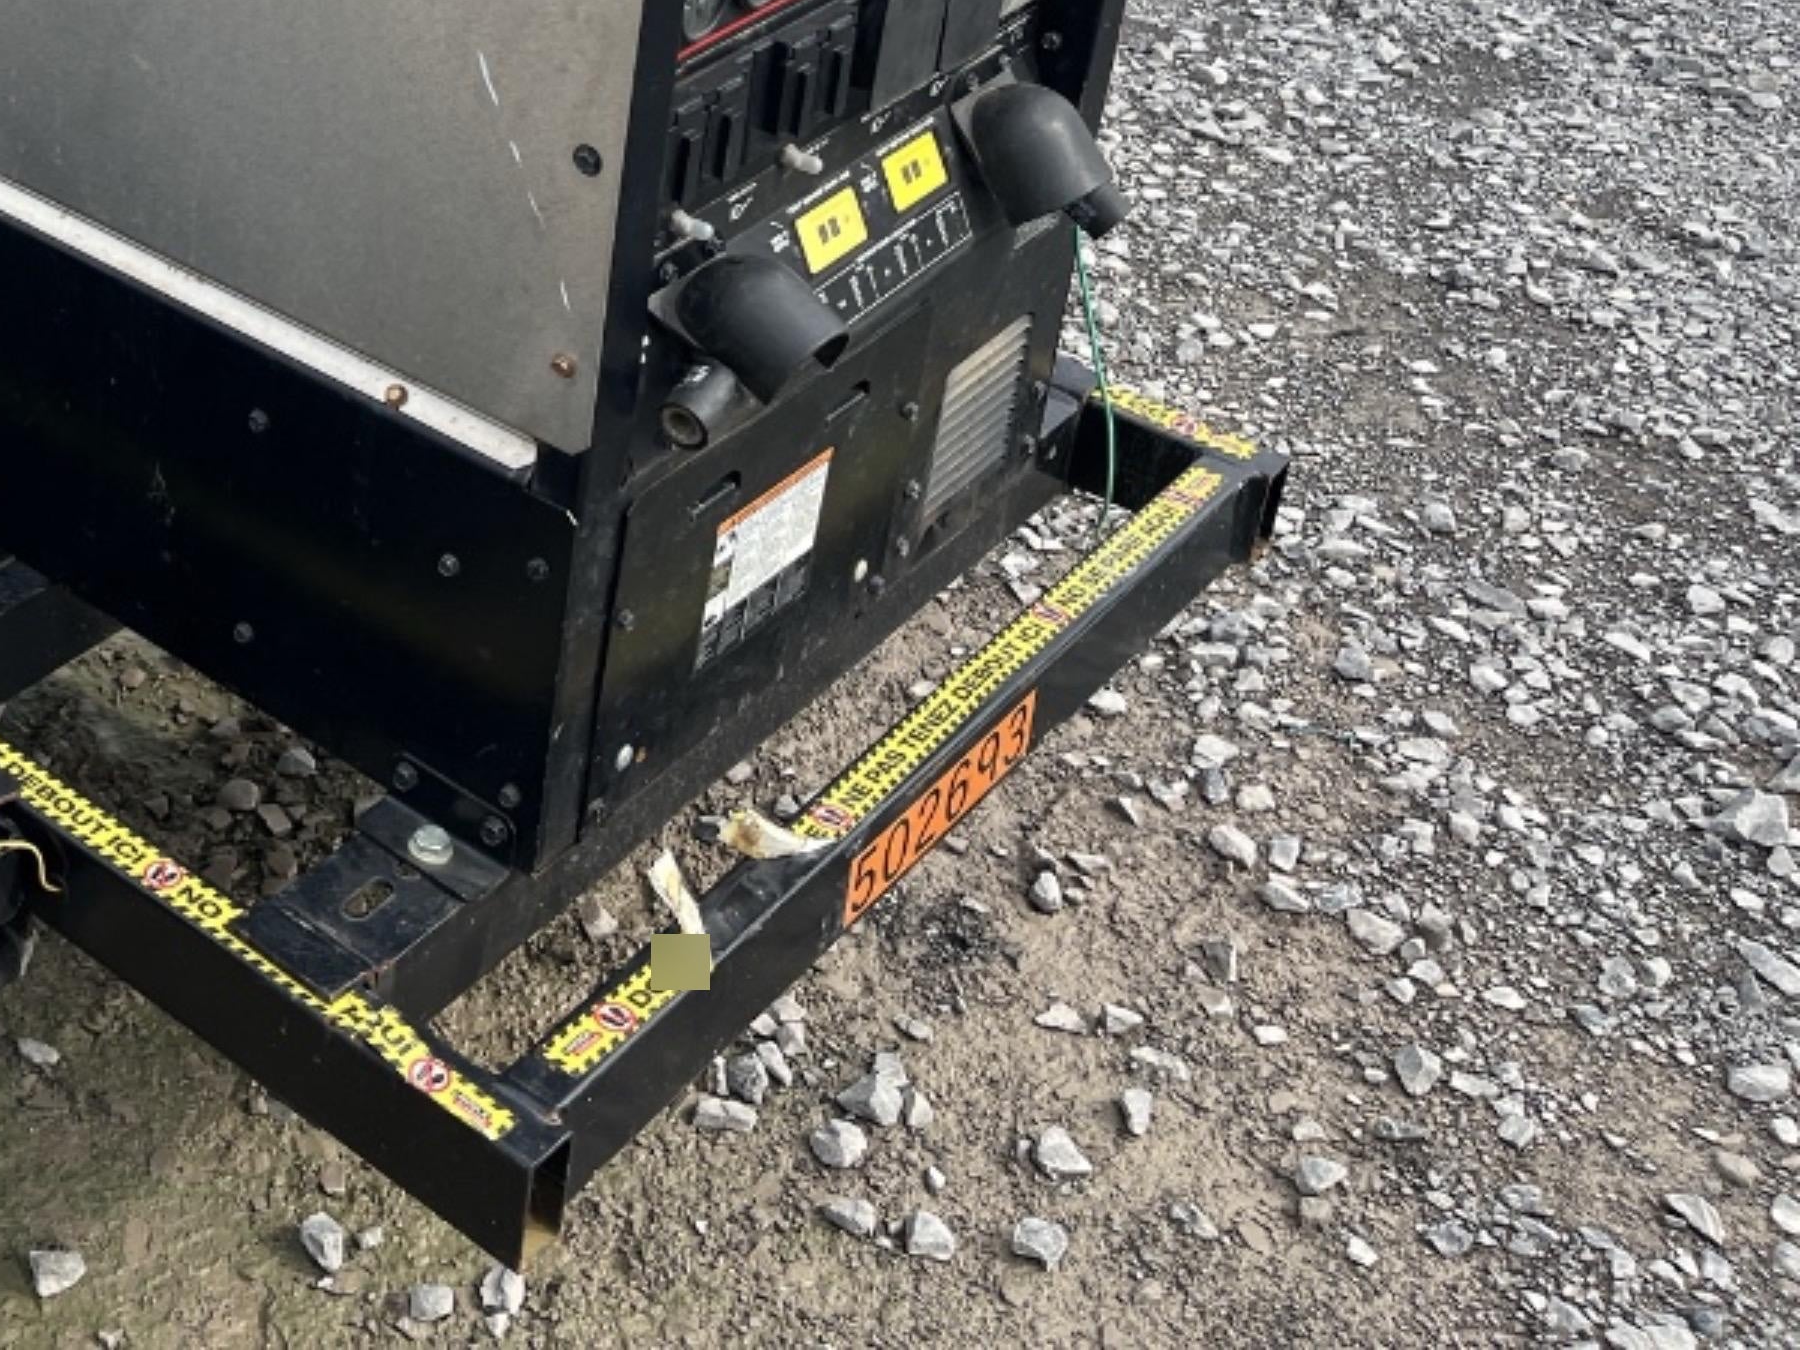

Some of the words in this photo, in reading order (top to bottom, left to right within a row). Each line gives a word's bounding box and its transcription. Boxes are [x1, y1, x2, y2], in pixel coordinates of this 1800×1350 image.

[864, 750, 907, 786] PAS
[897, 698, 960, 749] TENEZ
[5, 760, 111, 839] DEBOUT
[109, 832, 146, 866] ICI
[851, 704, 1028, 913] 502693
[178, 884, 223, 920] NO
